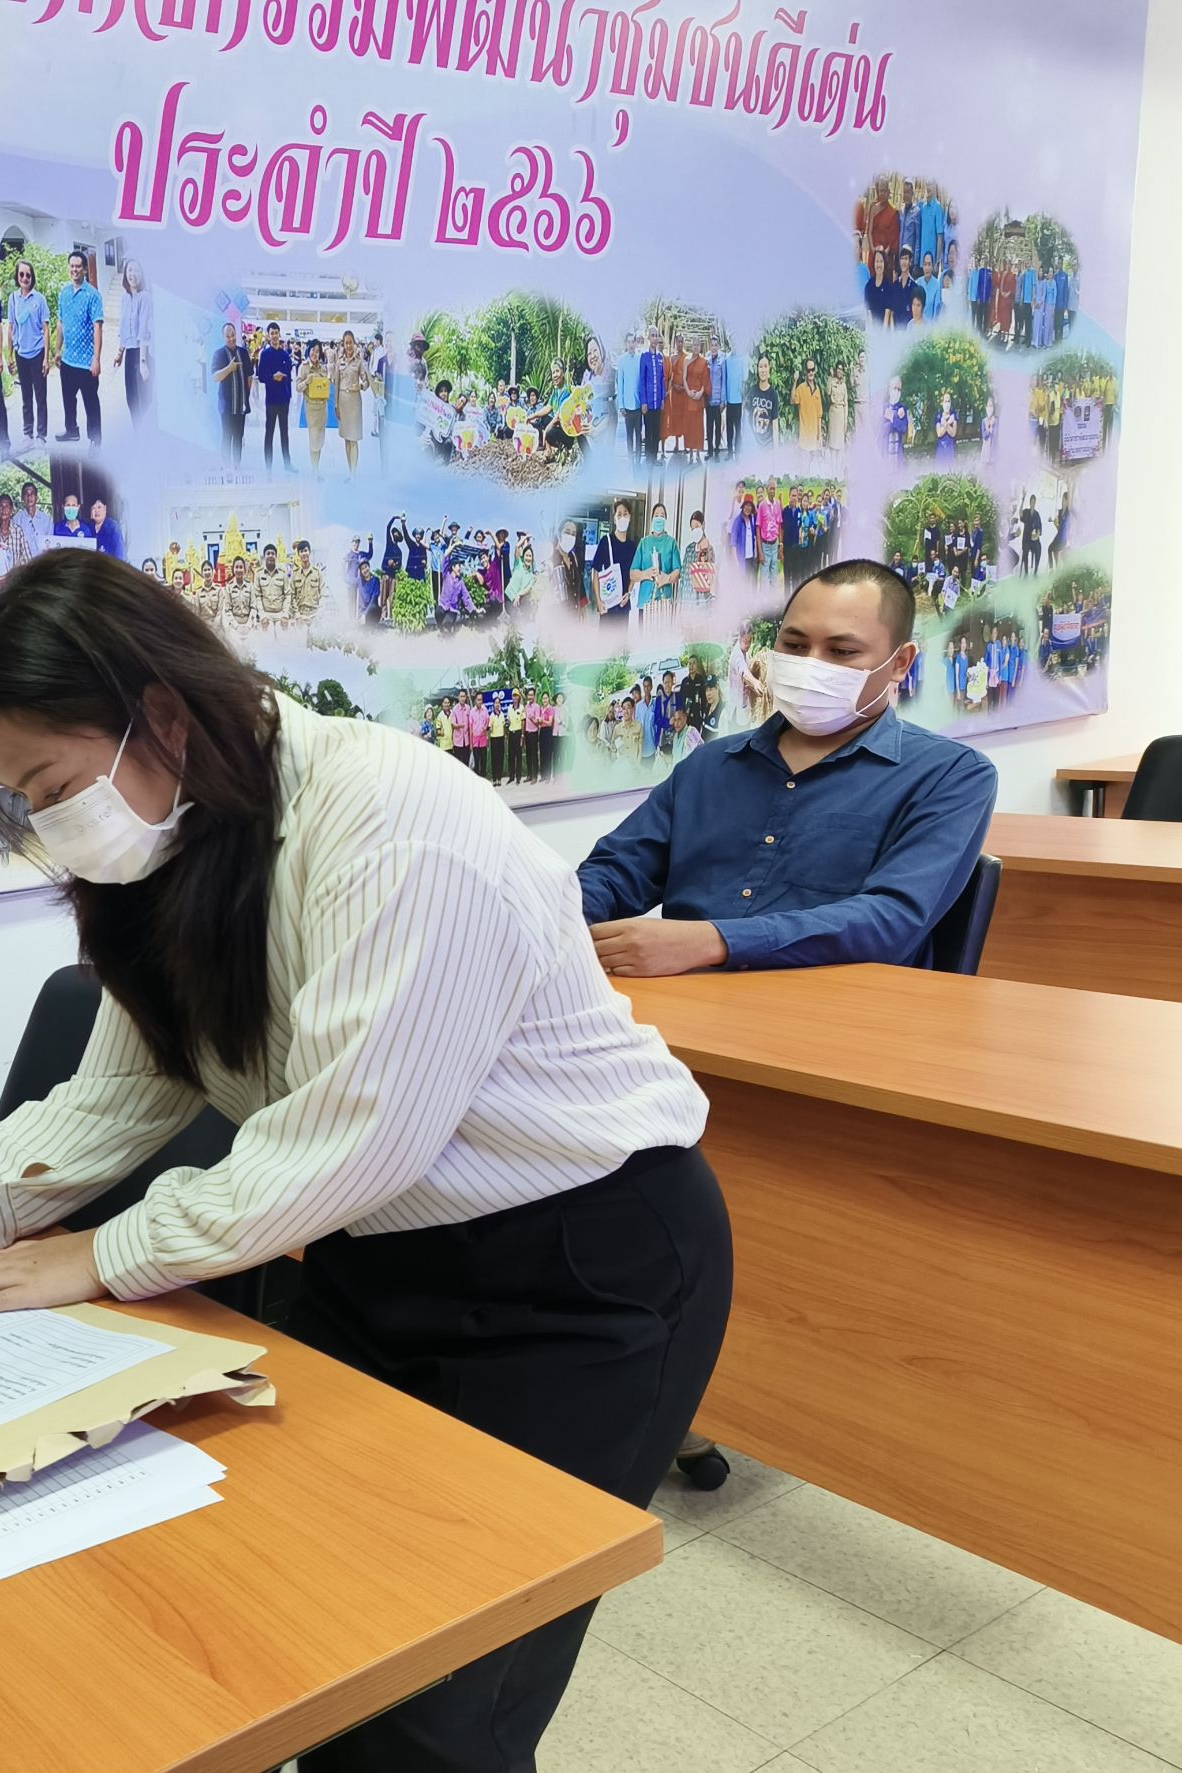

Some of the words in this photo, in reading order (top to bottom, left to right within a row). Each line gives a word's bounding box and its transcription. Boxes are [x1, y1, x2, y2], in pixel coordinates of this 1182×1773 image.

[115, 81, 428, 252] ประจำปี
[432, 137, 613, 256] ๒๕๖๖
